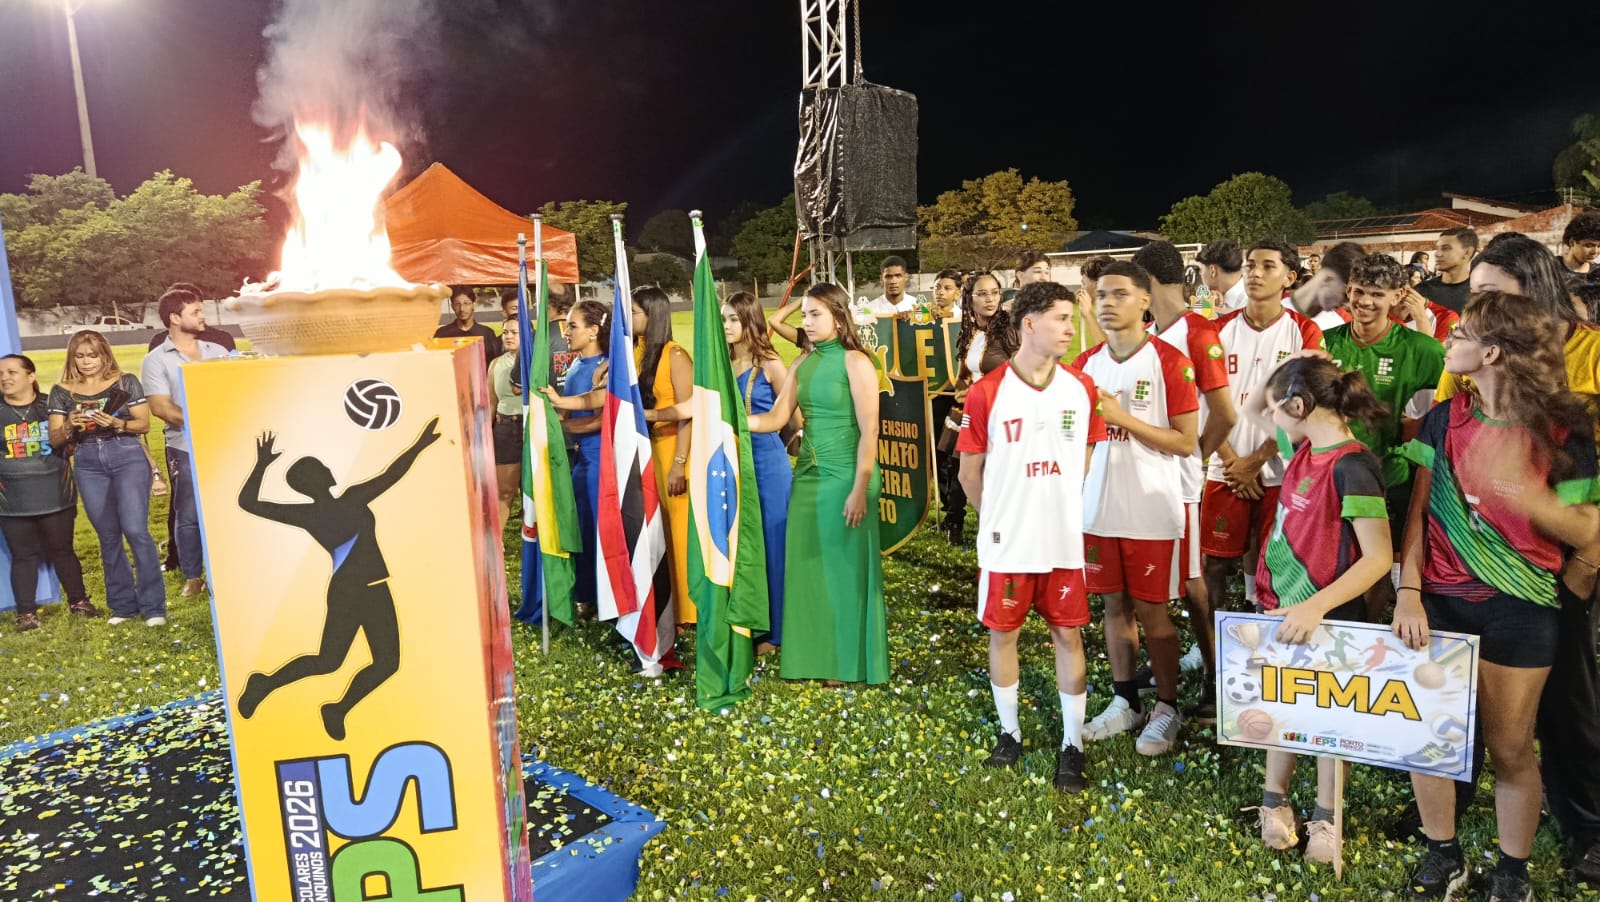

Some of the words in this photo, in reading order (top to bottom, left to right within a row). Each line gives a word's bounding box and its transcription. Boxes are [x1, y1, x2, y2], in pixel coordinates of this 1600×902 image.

[914, 329, 936, 377] E
[882, 419, 919, 440] ENSINO
[1003, 418, 1023, 443] 17
[4, 441, 53, 459] JEPS
[1026, 460, 1062, 478] IFMA
[1261, 665, 1422, 721] IFMA
[1309, 736, 1336, 748] JEPS
[284, 780, 321, 849] 2026
[311, 851, 329, 902] NQUINOS
